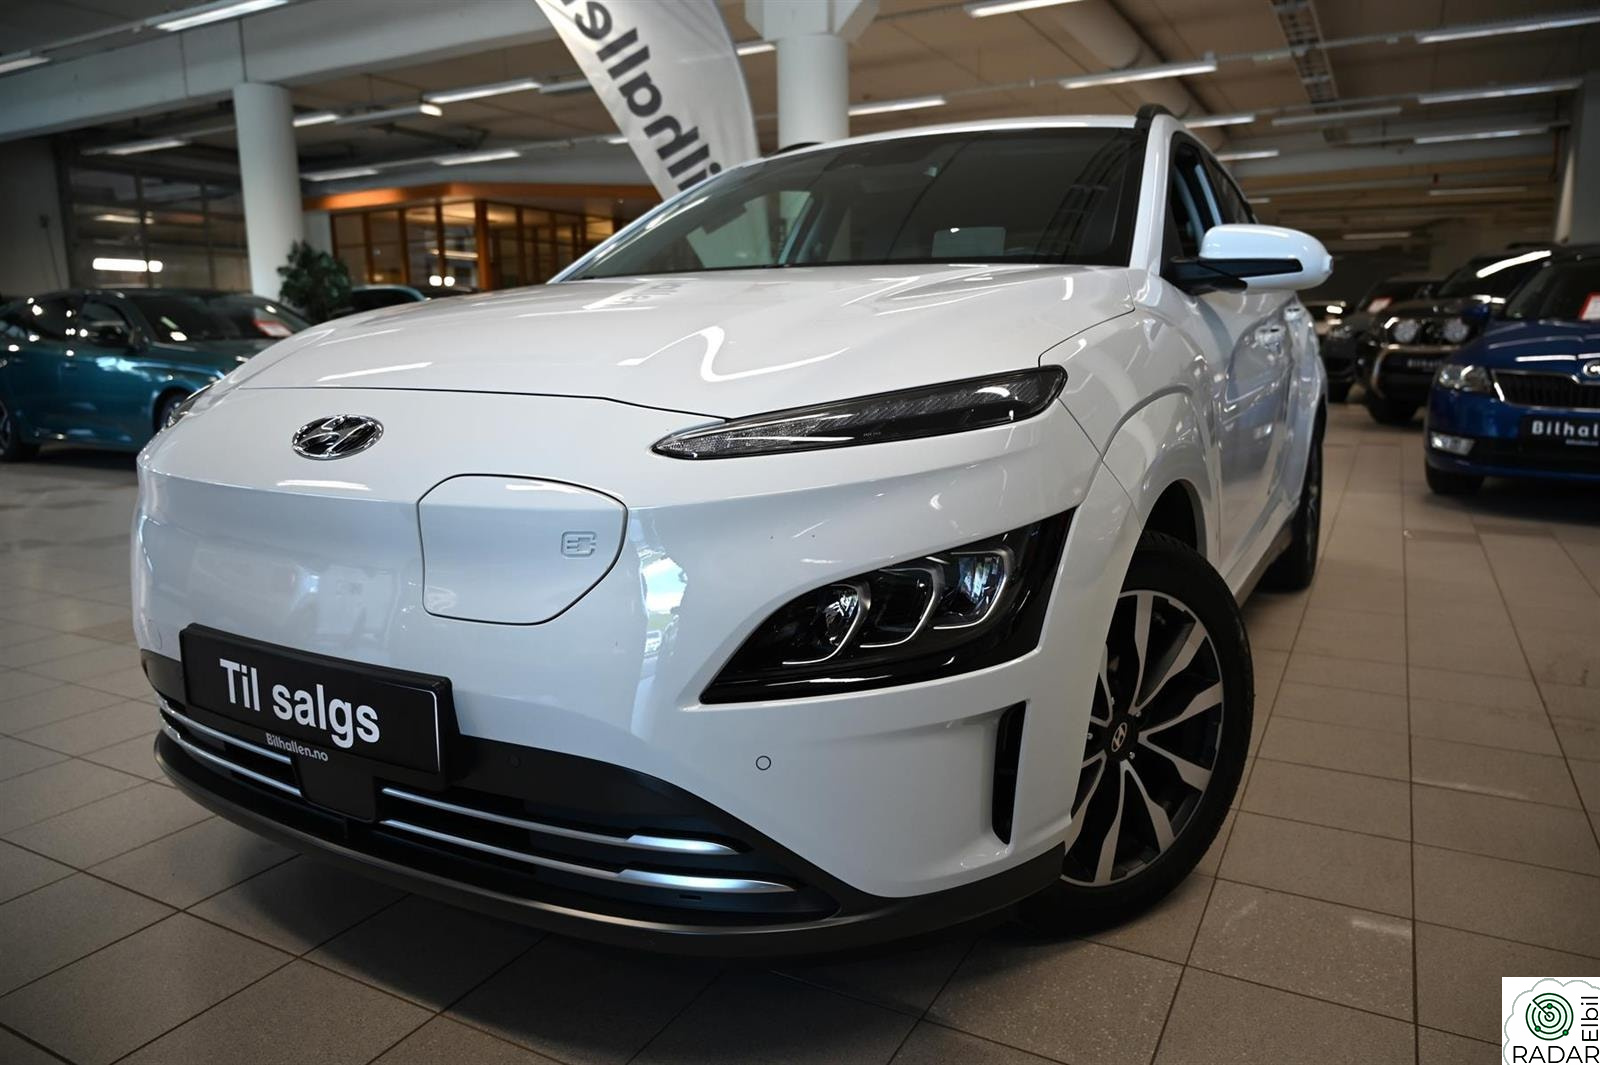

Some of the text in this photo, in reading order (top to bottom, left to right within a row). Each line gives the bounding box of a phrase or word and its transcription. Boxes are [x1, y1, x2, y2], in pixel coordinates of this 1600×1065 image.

[1532, 420, 1599, 438] Bilhal
[219, 658, 380, 748] Til salgs
[265, 732, 328, 761] Bilhallen.no
